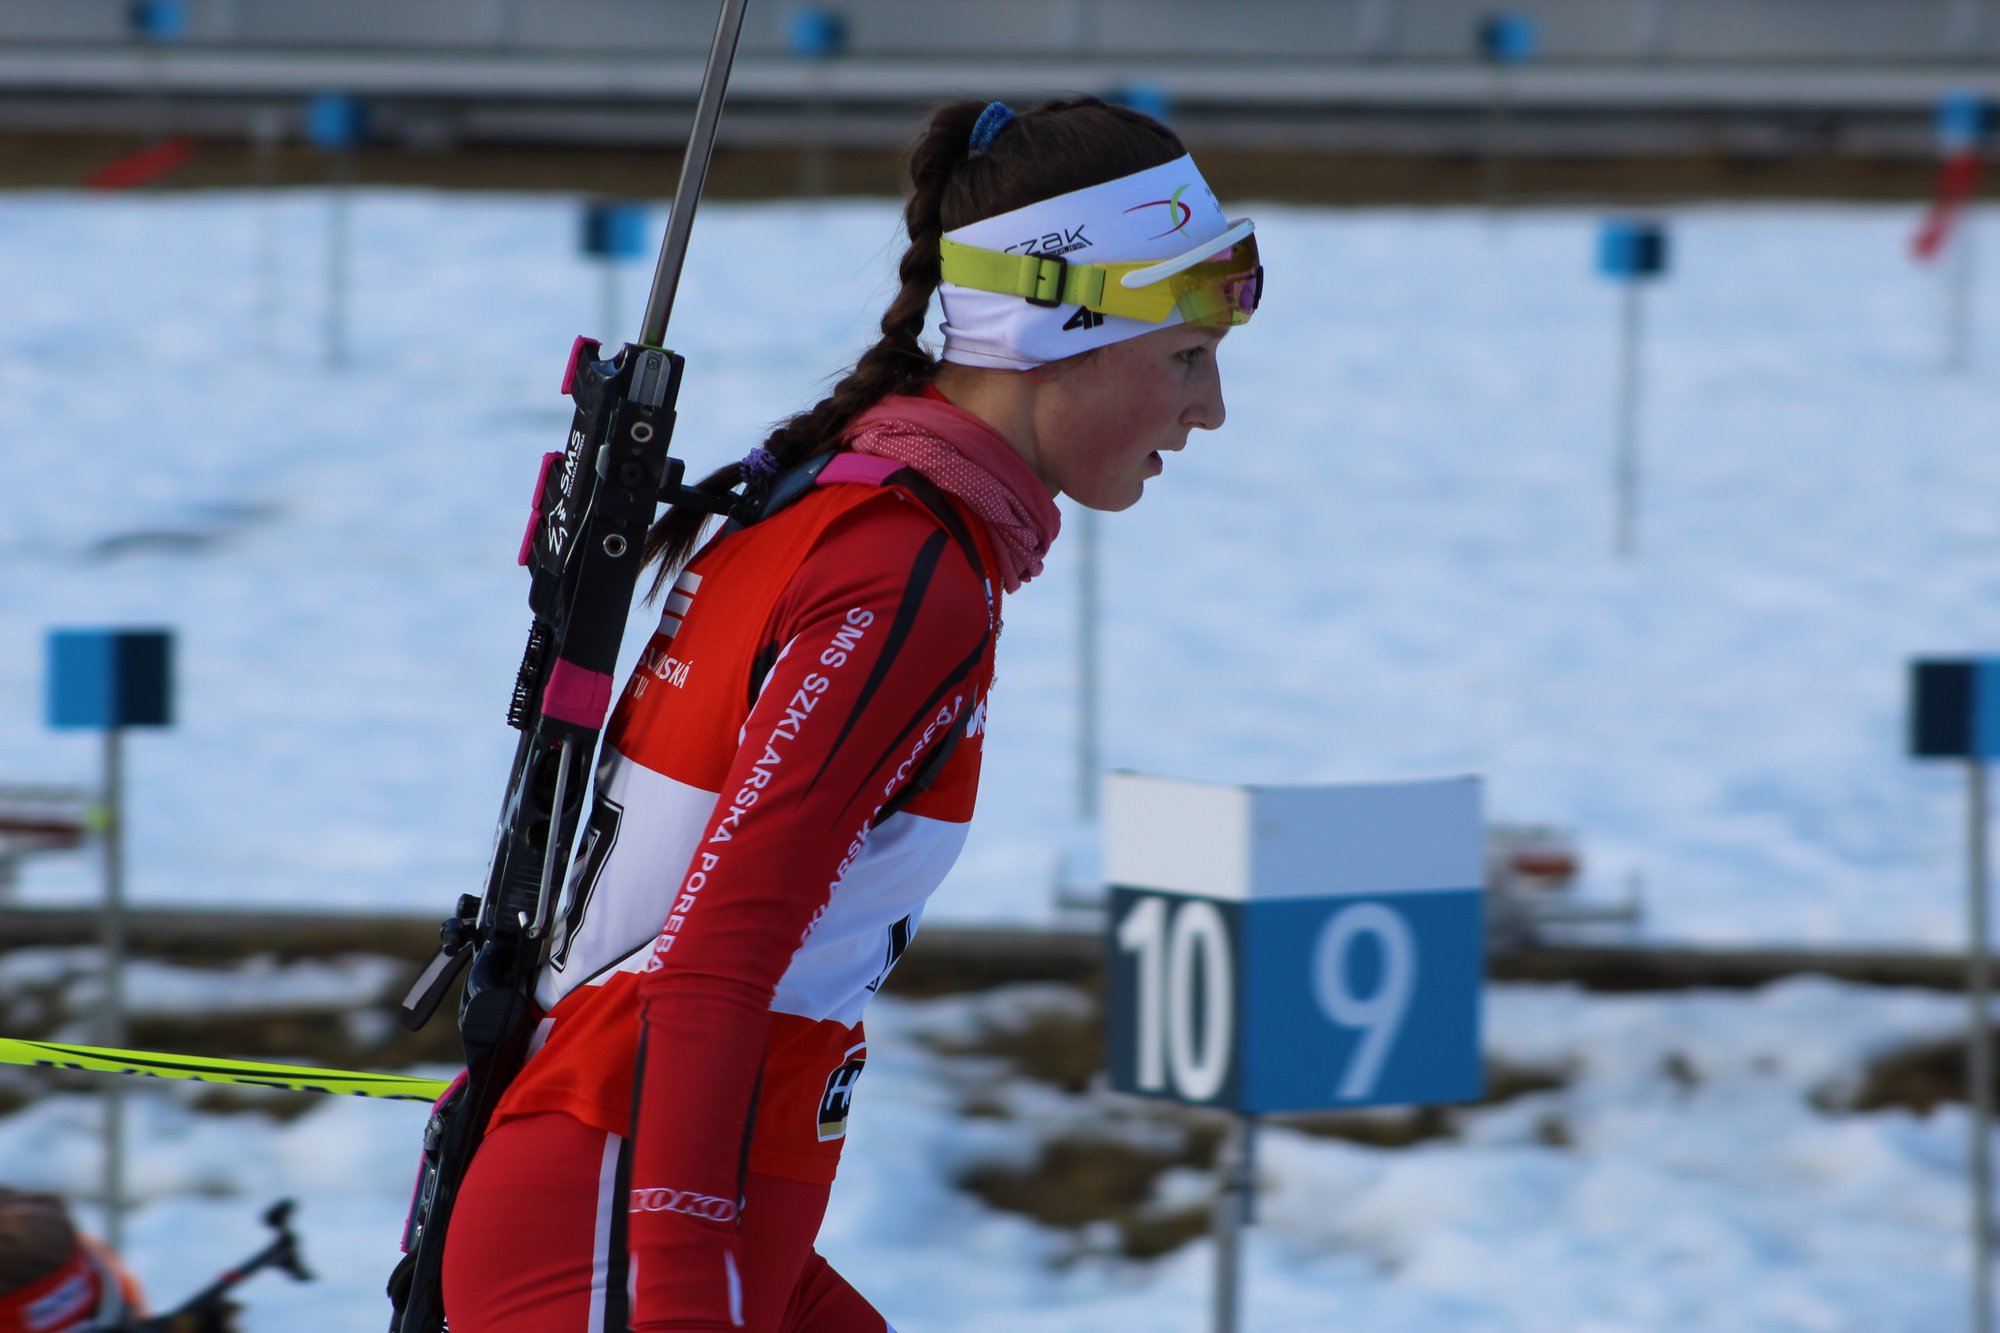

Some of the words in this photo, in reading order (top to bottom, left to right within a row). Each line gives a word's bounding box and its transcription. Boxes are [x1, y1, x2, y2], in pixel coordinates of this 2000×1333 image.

[561, 429, 581, 495] SMS
[820, 606, 874, 669] SMS
[708, 672, 830, 845] SZKLARSKA
[646, 852, 721, 974] POREBA
[1117, 896, 1234, 1101] 10
[1312, 901, 1416, 1099] 9
